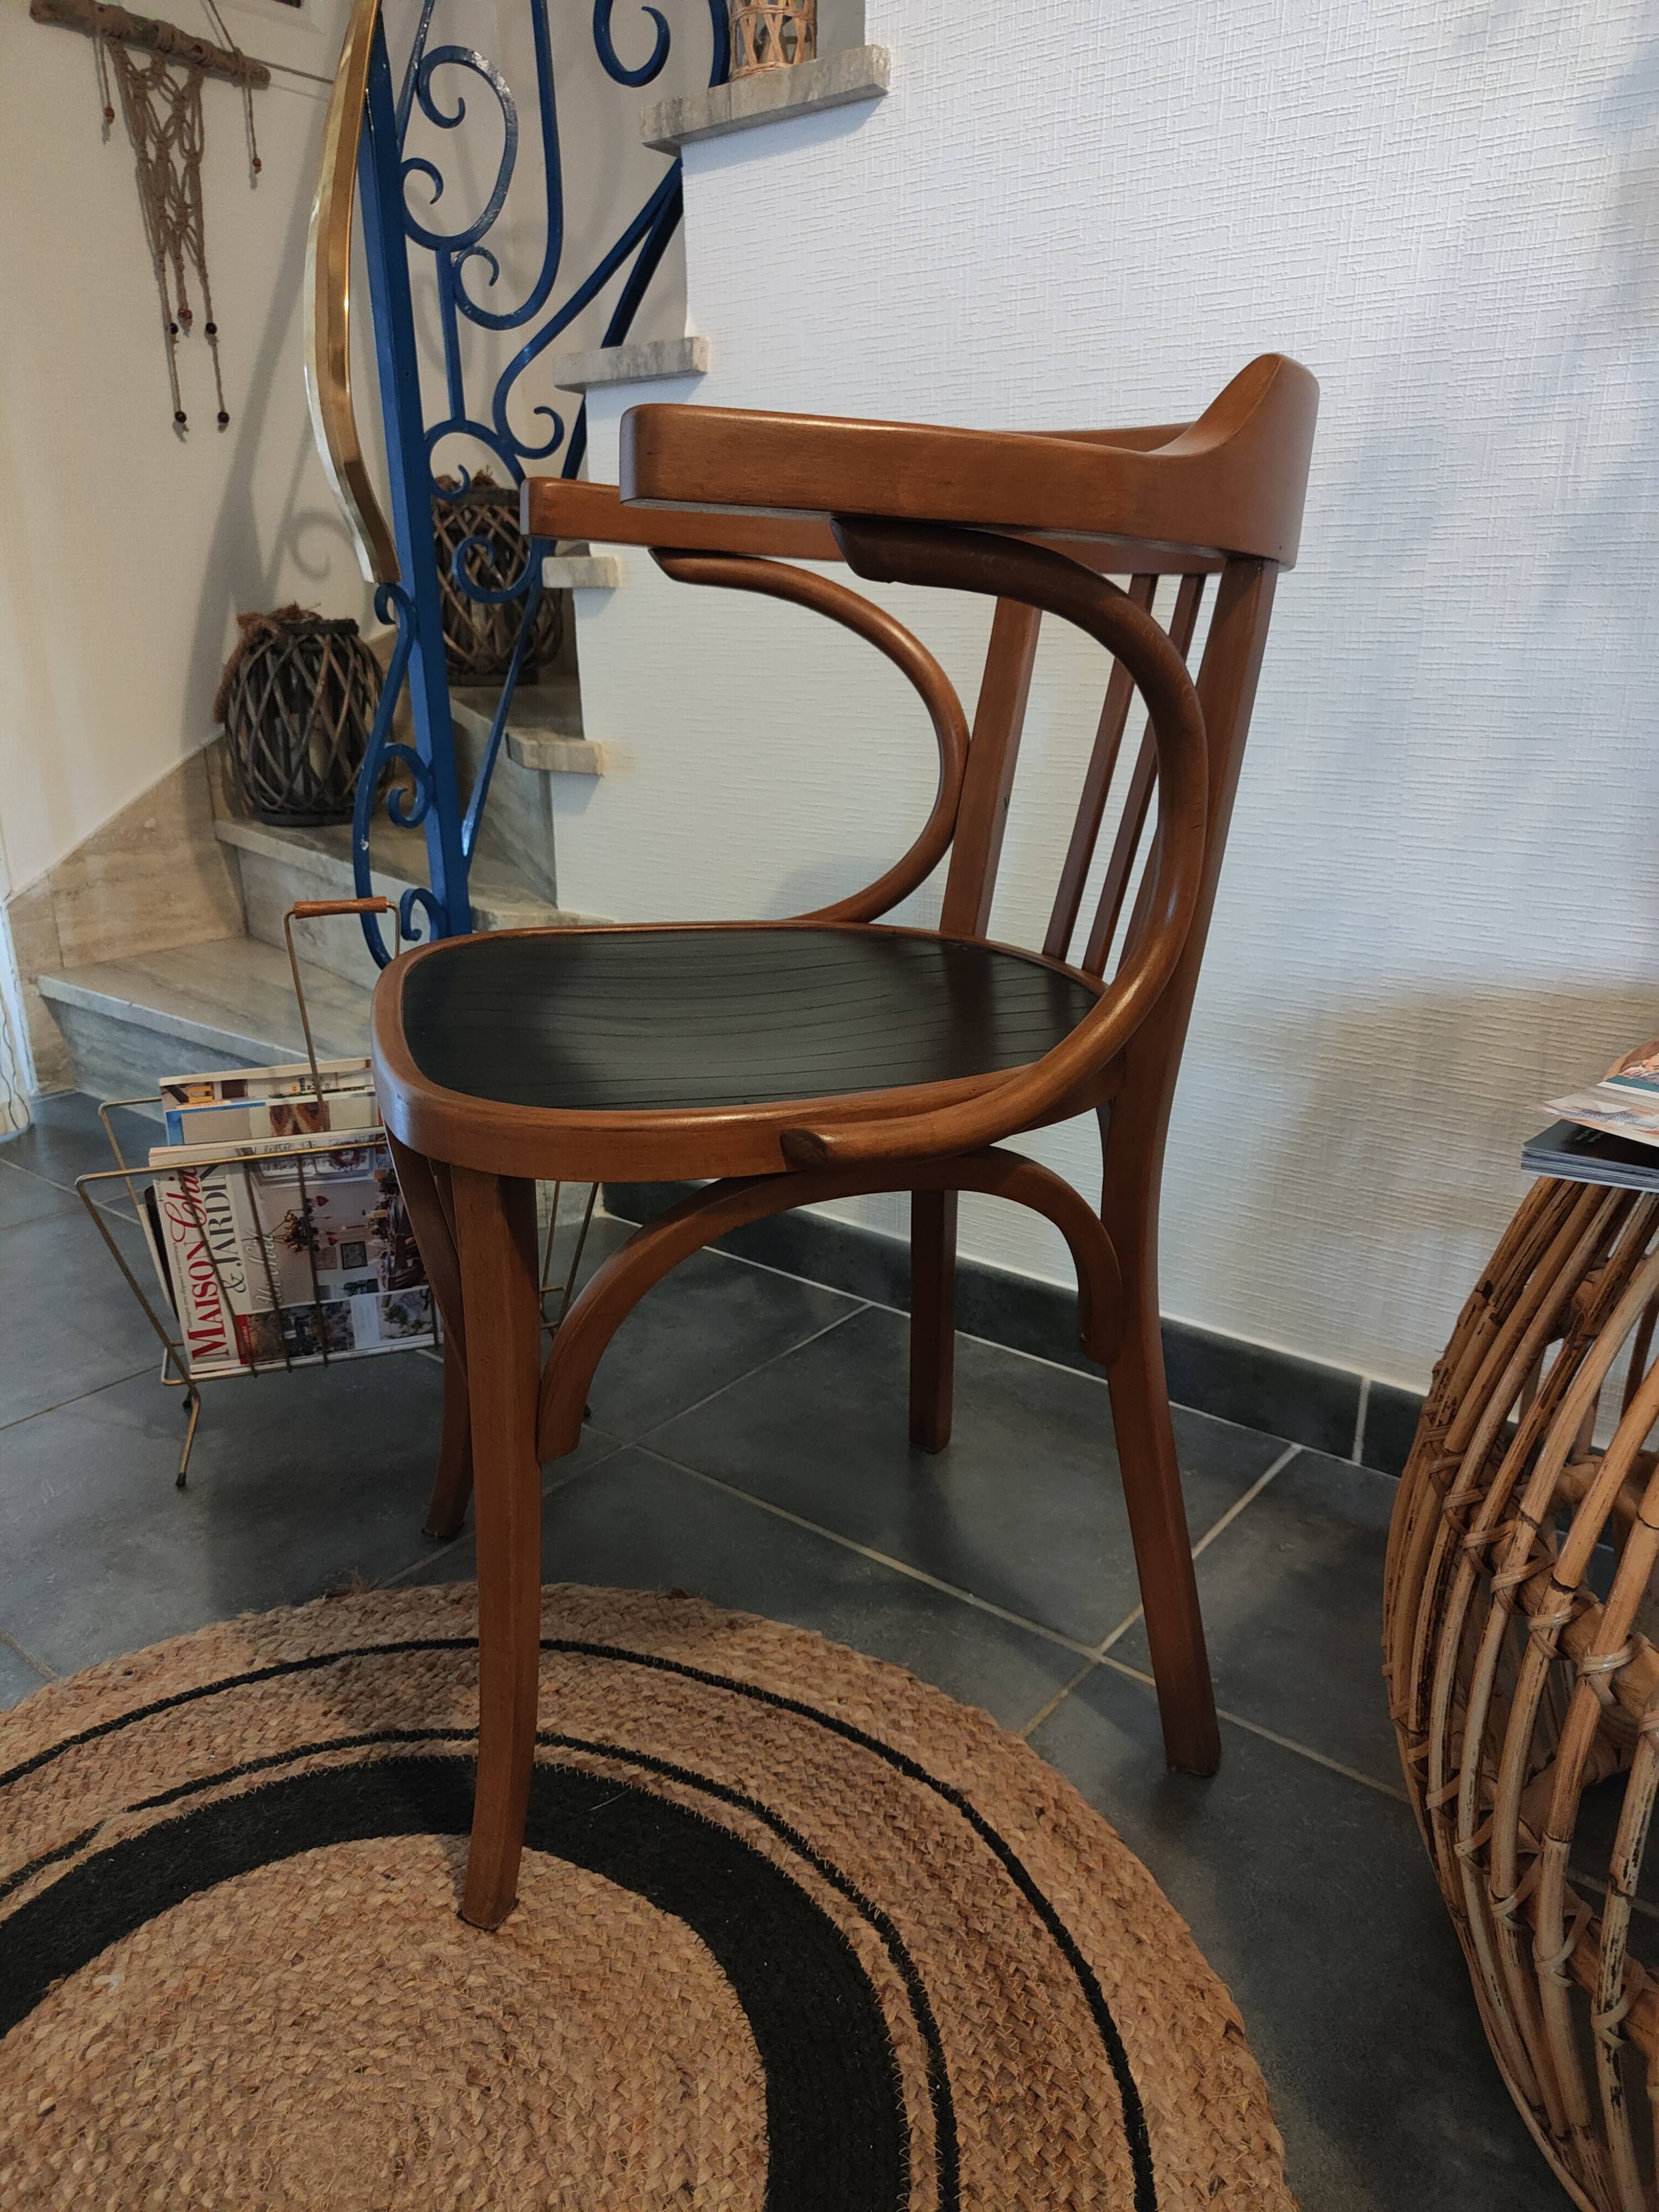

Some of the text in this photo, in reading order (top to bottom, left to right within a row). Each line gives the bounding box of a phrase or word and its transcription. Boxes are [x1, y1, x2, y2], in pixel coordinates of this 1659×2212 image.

[200, 1165, 246, 1293] & JARDIN
[184, 1240, 229, 1360] MAISON
